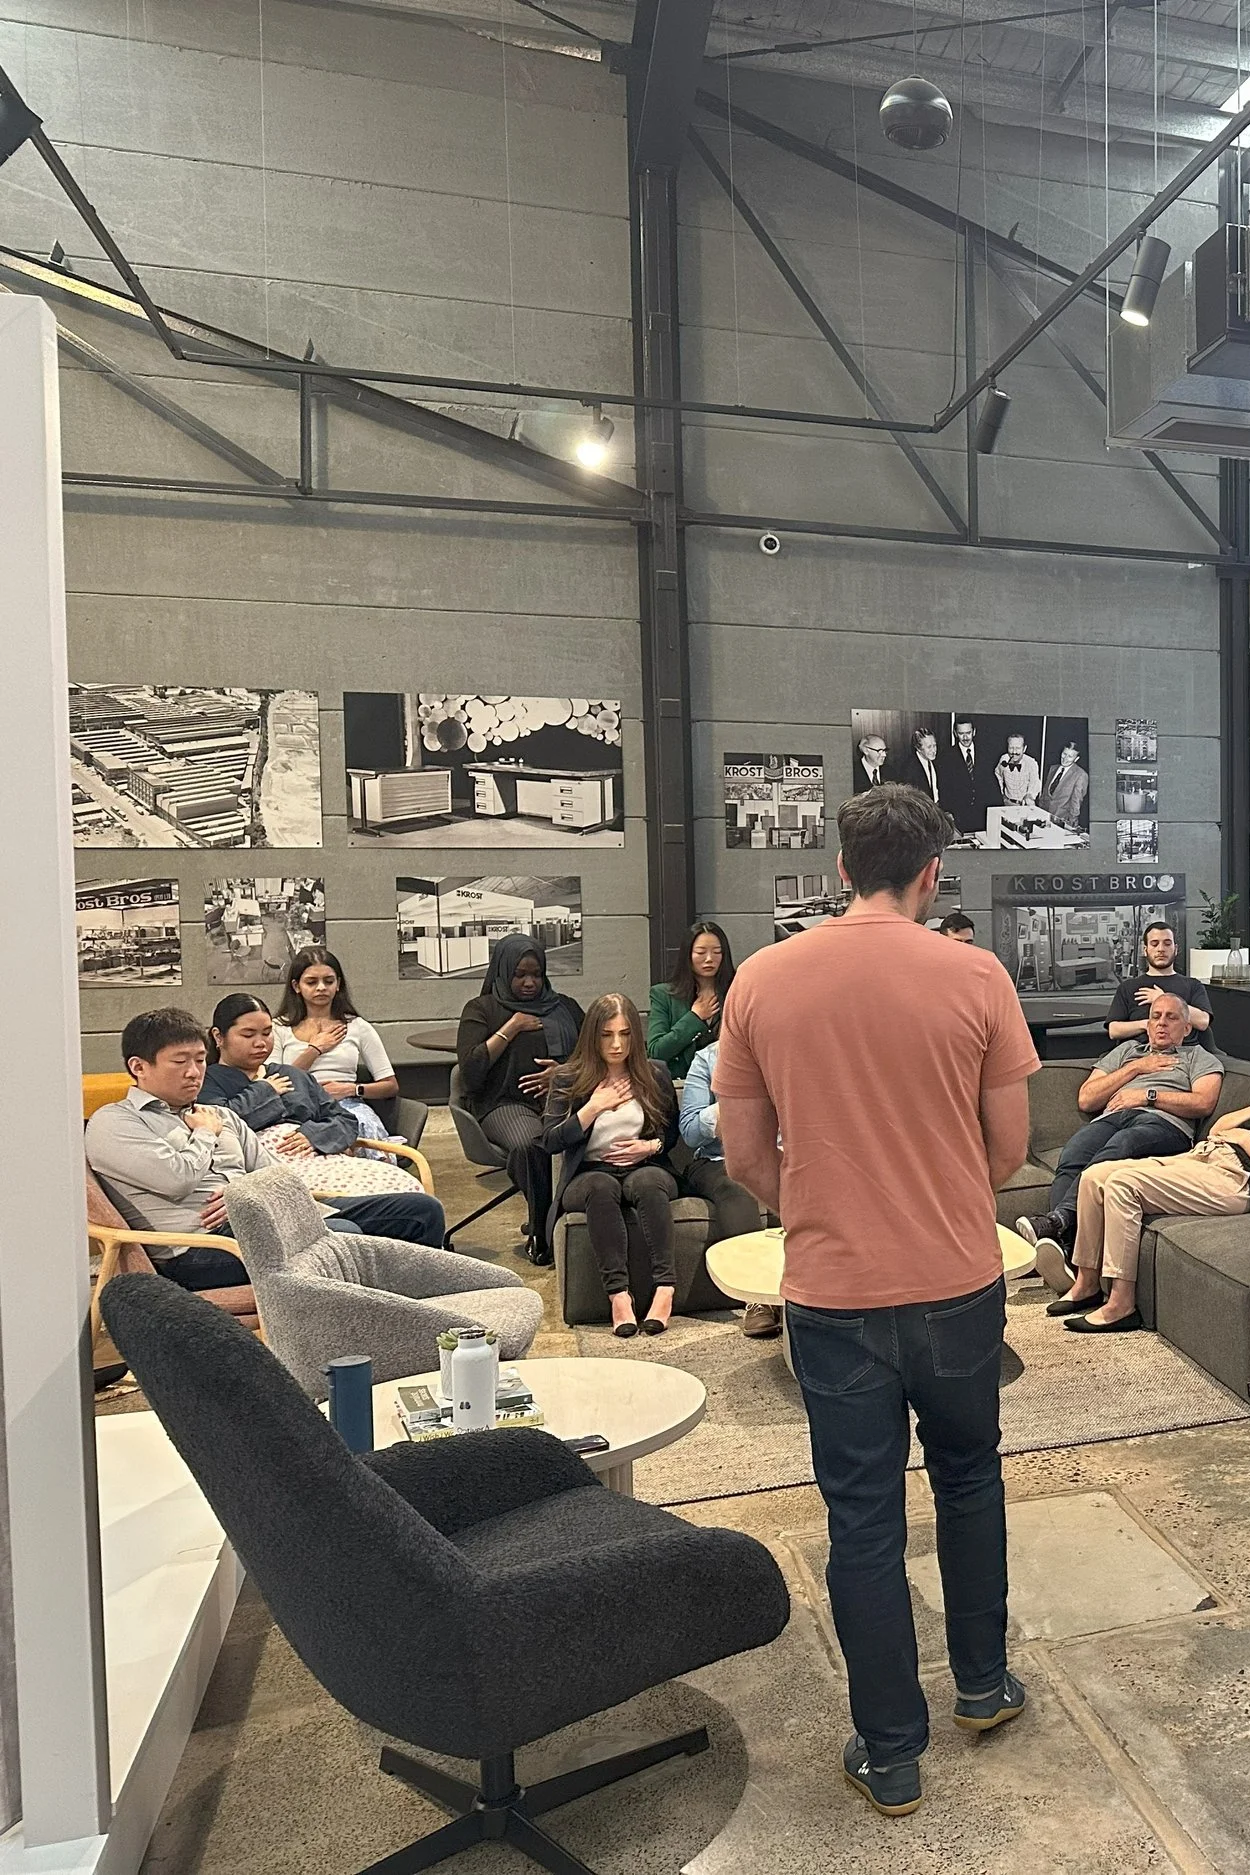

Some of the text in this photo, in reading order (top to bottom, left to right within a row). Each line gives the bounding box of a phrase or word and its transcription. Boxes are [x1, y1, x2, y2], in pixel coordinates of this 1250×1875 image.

[725, 766, 823, 778] KROST BROS.
[1014, 876, 1100, 892] KROST
[105, 892, 152, 907] Bros
[460, 889, 484, 900] KROST
